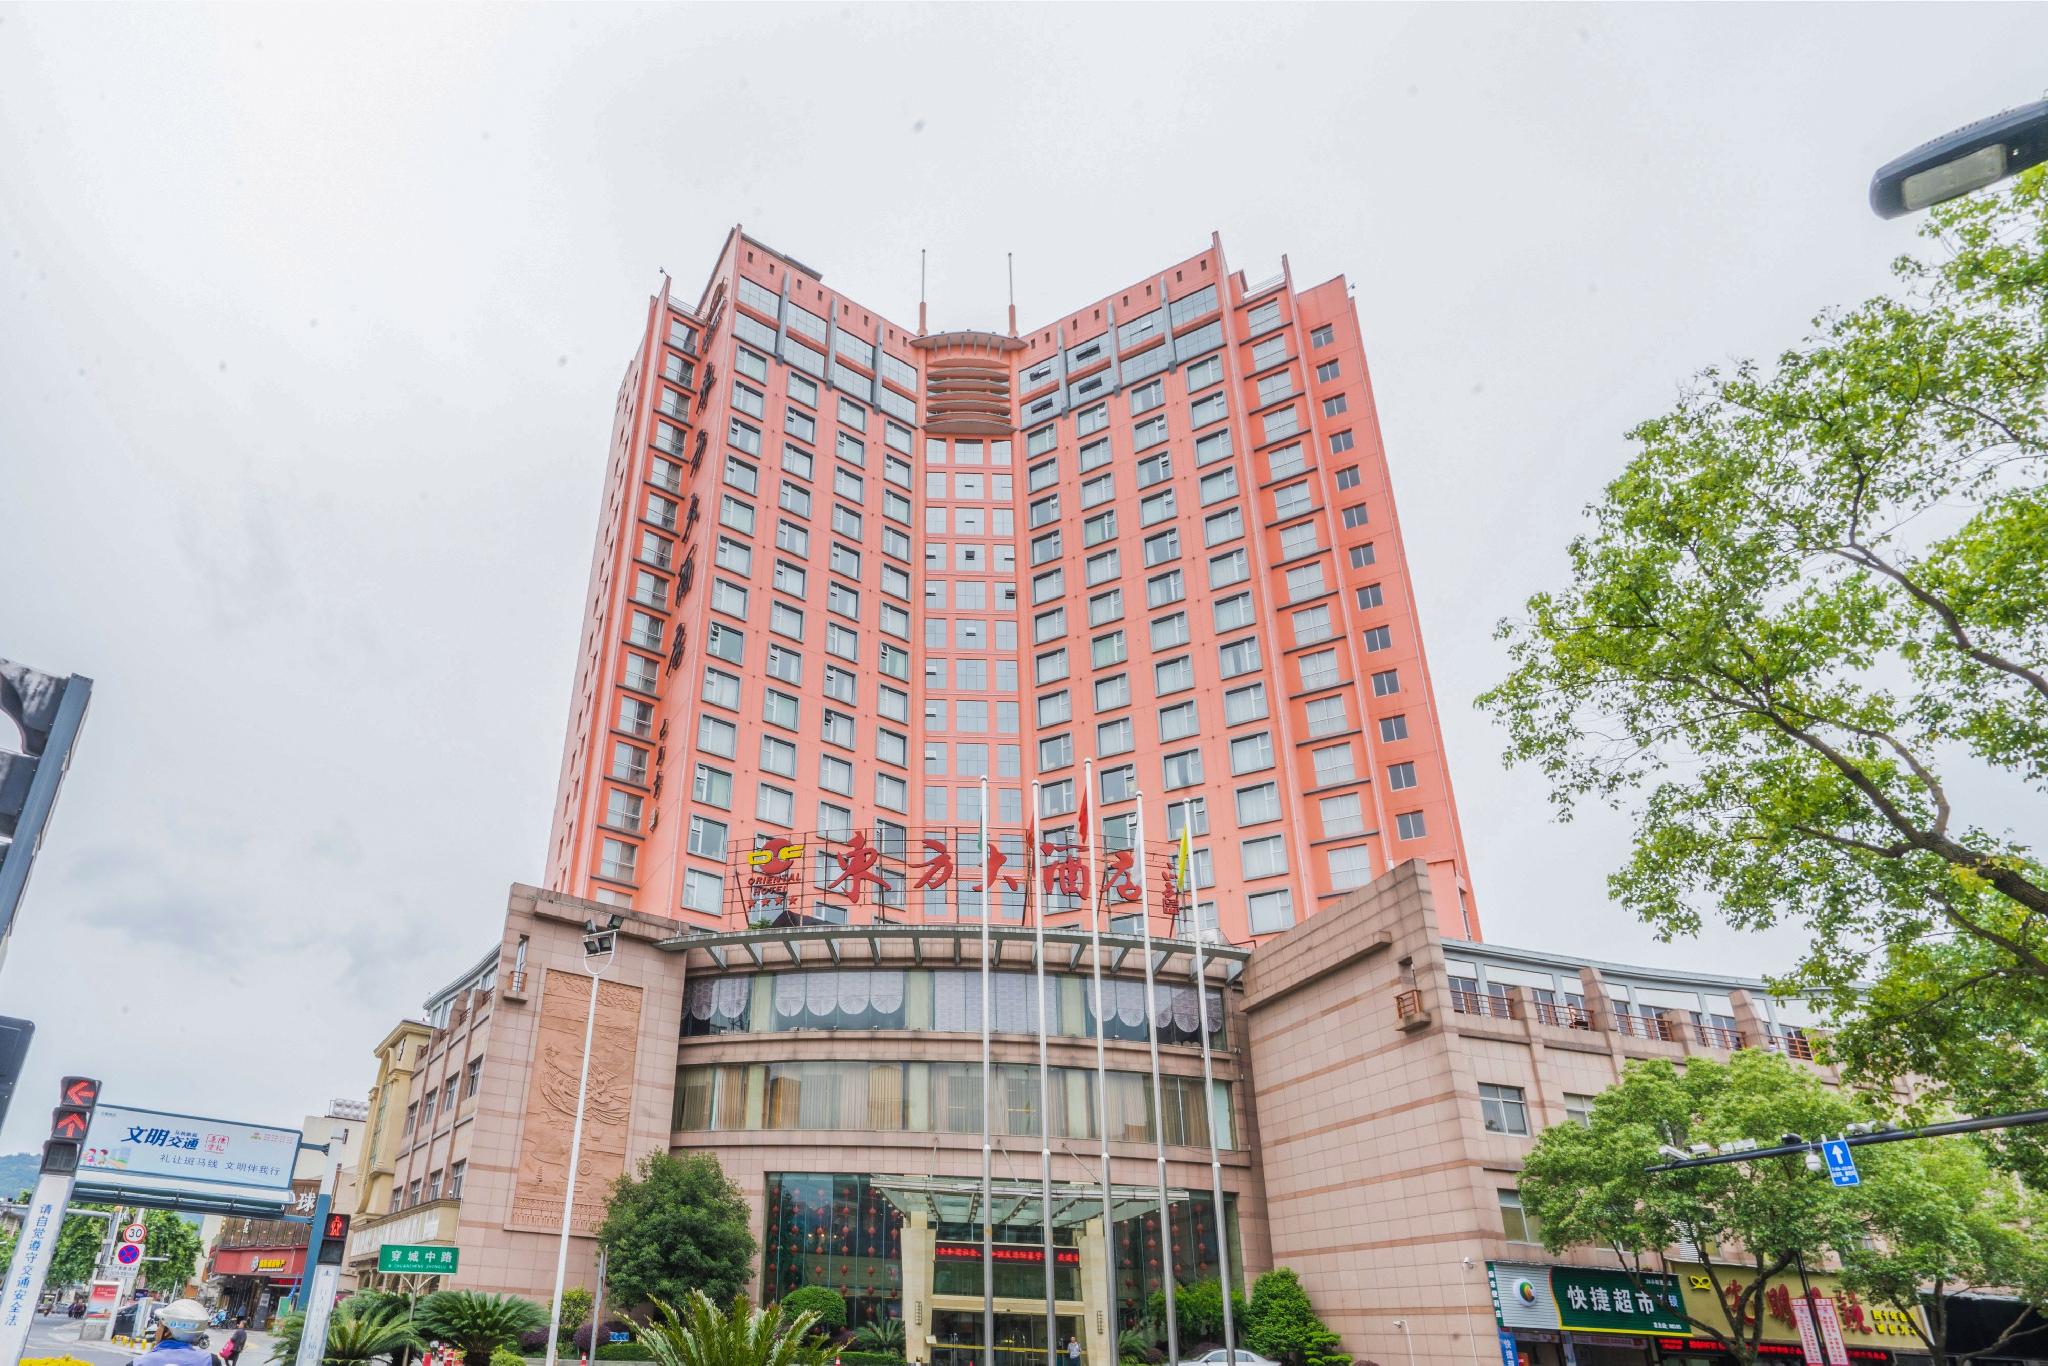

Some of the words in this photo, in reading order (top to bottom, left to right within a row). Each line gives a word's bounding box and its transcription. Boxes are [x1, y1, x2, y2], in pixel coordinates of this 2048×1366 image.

[224, 1160, 281, 1176] 文明伴我行
[128, 1228, 143, 1238] 30
[391, 1249, 453, 1263] 穿城中路
[5, 1203, 53, 1327] 请自觉遵守交通安全法
[1567, 1284, 1655, 1315] 快捷超市
